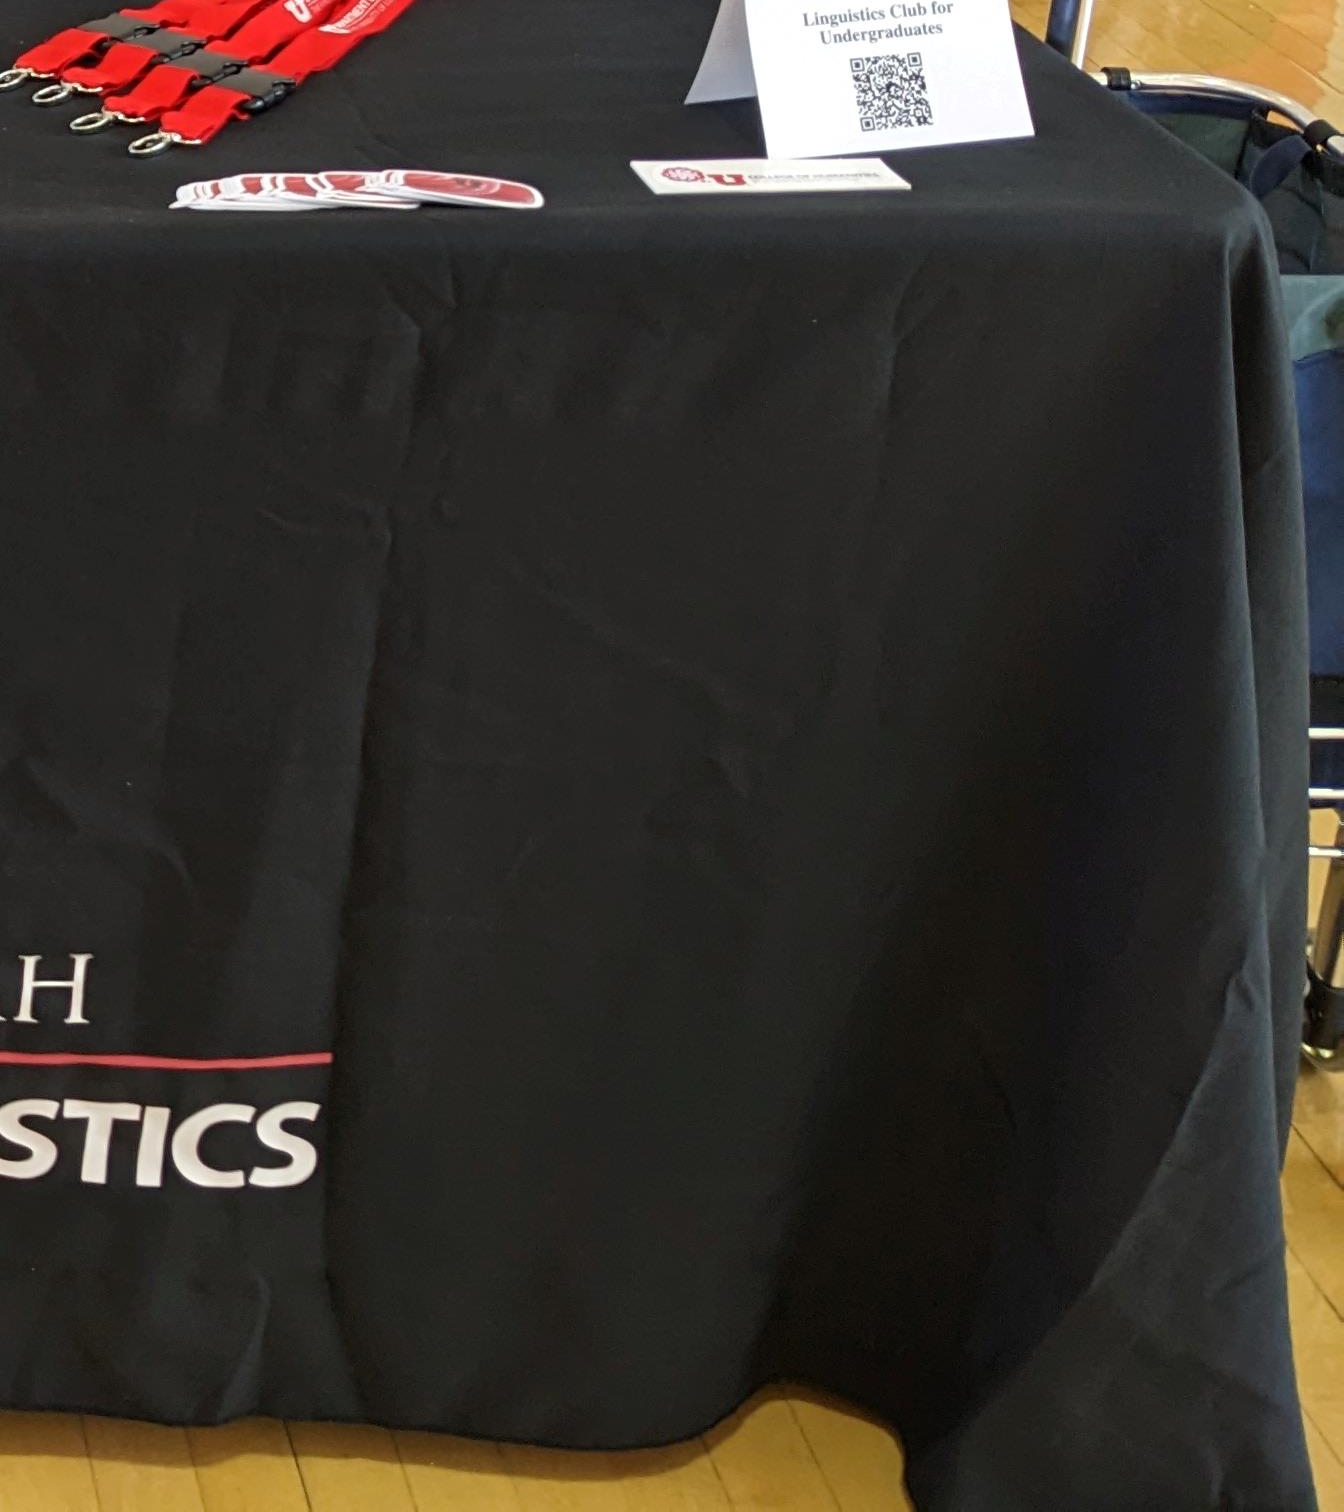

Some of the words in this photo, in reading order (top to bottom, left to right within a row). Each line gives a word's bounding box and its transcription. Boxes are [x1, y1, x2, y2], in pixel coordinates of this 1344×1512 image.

[803, 6, 886, 28] Linguistics
[889, 3, 927, 19] Club
[931, 0, 954, 15] for
[820, 22, 943, 45] Undergraduates
